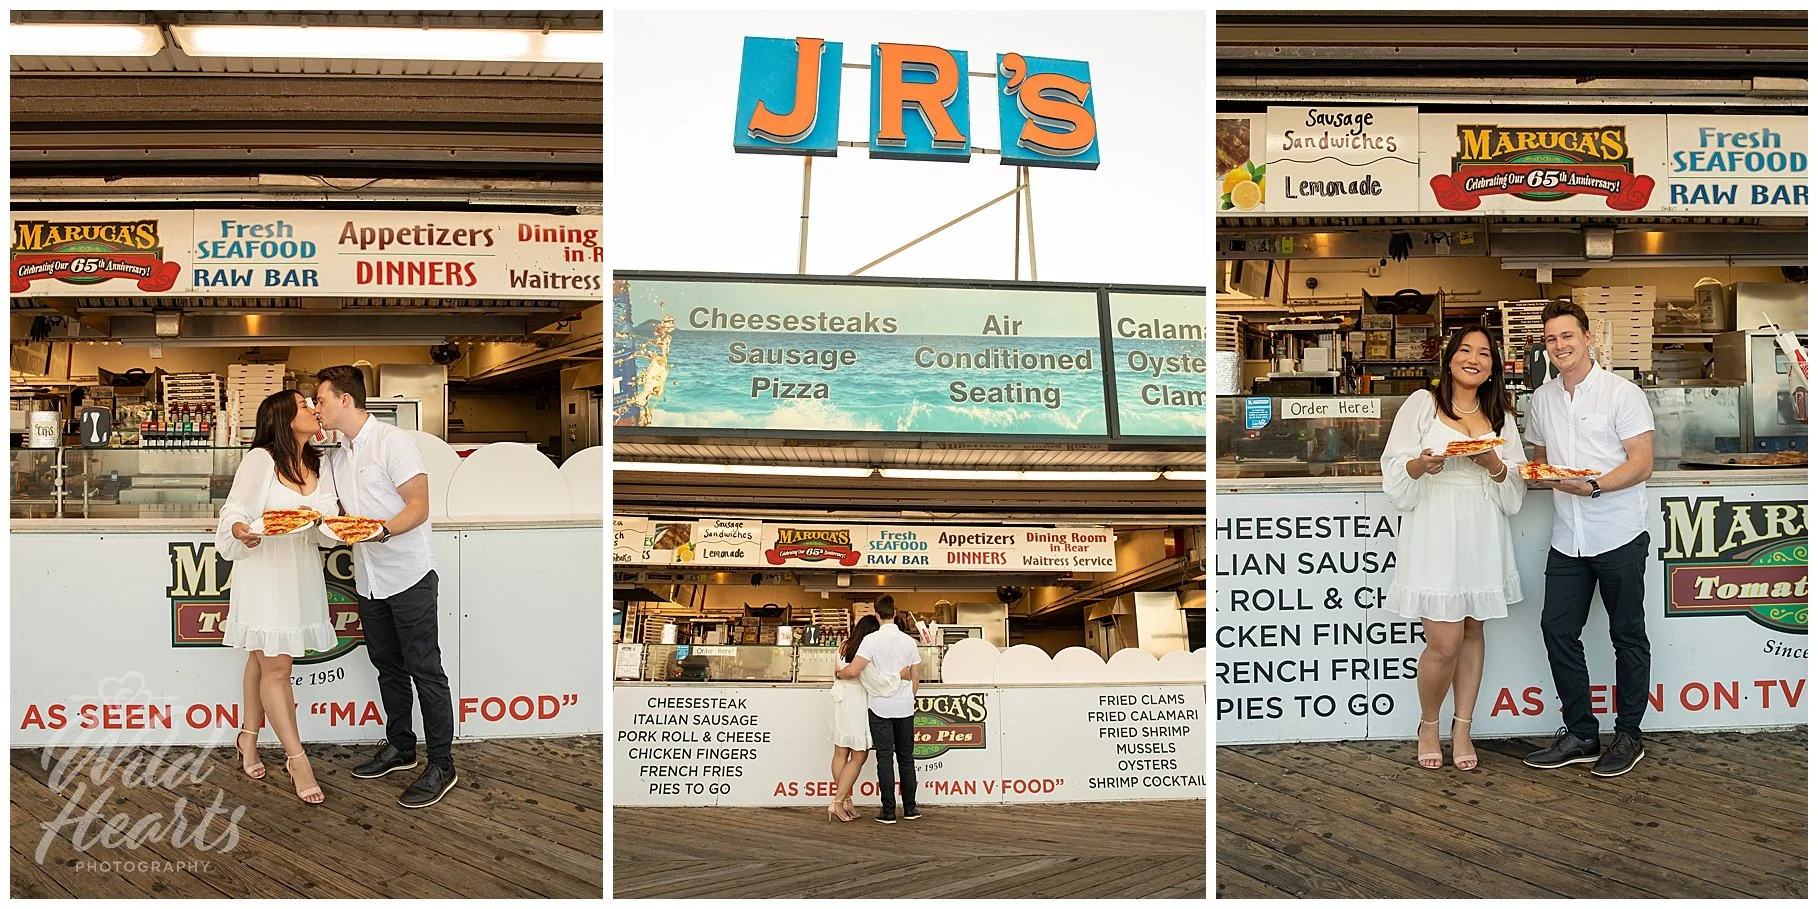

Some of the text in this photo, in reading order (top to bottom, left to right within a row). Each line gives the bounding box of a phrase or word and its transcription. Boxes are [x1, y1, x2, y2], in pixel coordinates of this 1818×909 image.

[1306, 109, 1373, 135] Sausage
[1283, 130, 1397, 152] Sandwiches
[1699, 127, 1781, 148] Fresh
[1673, 151, 1808, 172] SEAFOOD
[1285, 175, 1382, 199] Lemonade
[1466, 176, 1507, 191] Celebrating
[1509, 173, 1524, 185] Our
[1567, 175, 1620, 192] Anniversary!
[1670, 184, 1808, 205] RAW BAR
[221, 220, 293, 238] Fresh
[338, 221, 494, 250] Appetizers
[518, 223, 599, 247] Dining
[198, 241, 316, 259] SEAFOOD
[564, 247, 584, 262] in
[19, 262, 54, 276] Celebrating
[55, 261, 69, 270] Our
[105, 263, 150, 277] Anniversary!
[194, 269, 319, 286] RAW BAR
[356, 260, 478, 287] DINNERS
[510, 270, 600, 290] Waitress
[689, 306, 898, 333] Cheesesteaks
[982, 314, 1023, 336] Air
[1117, 317, 1206, 340] Calam
[728, 342, 857, 371] Sausage
[915, 346, 1093, 370] Conditioned
[751, 377, 829, 399] Pizza
[949, 381, 1061, 409] Seating
[1291, 401, 1374, 415] Order Here!
[704, 529, 752, 539] Sandwiches
[714, 520, 743, 532] Sausage
[1216, 516, 1402, 539] HEESESTEA
[1664, 501, 1808, 559] MAR
[881, 531, 916, 540] Fresh
[938, 532, 1015, 547] Appetizers
[1026, 532, 1107, 545] Dining Room
[703, 548, 744, 558] Lemonade
[869, 541, 927, 550] SEAFOOD
[1050, 543, 1090, 552] in Rear
[867, 555, 928, 565] RAW BAR
[947, 552, 1007, 565] DINNERS
[1022, 556, 1112, 567] Waitress Service
[1231, 589, 1313, 612] ROLL
[1324, 587, 1343, 609] &
[310, 667, 345, 685] 1950
[1332, 658, 1417, 681] FRIES
[647, 698, 747, 710] CHEESESTEAK
[1099, 694, 1185, 705] FRIED CLAMS
[1491, 687, 1544, 717] AS
[1680, 681, 1740, 712] ON
[1755, 679, 1805, 709] TV
[20, 704, 67, 730] AS
[80, 704, 172, 729] SEEN
[185, 704, 238, 729] ON
[311, 701, 383, 726] "MA
[460, 694, 578, 723] FOOD"
[1217, 694, 1394, 720] PIES TO GO
[633, 714, 758, 726] ITALIAN SAUSAGE
[1088, 710, 1198, 722] FRIED CALAMARI
[618, 731, 770, 743] PORK ROLL & CHEESE
[937, 730, 972, 741] Pies
[1100, 726, 1190, 738] FRIED SHRIMP
[629, 748, 757, 760] CHICKEN FINGERS
[1117, 743, 1176, 754] MUSSELS
[640, 766, 743, 777] FRENCH FRIES
[925, 761, 942, 771] 1950
[1118, 759, 1177, 770] OYSTERS
[649, 783, 731, 795] PIES TO GO
[774, 782, 798, 796] AS
[926, 780, 976, 795] "MAN
[982, 780, 995, 794] V
[1002, 778, 1064, 794] FOOD"
[1089, 777, 1138, 788] SHRIMP
